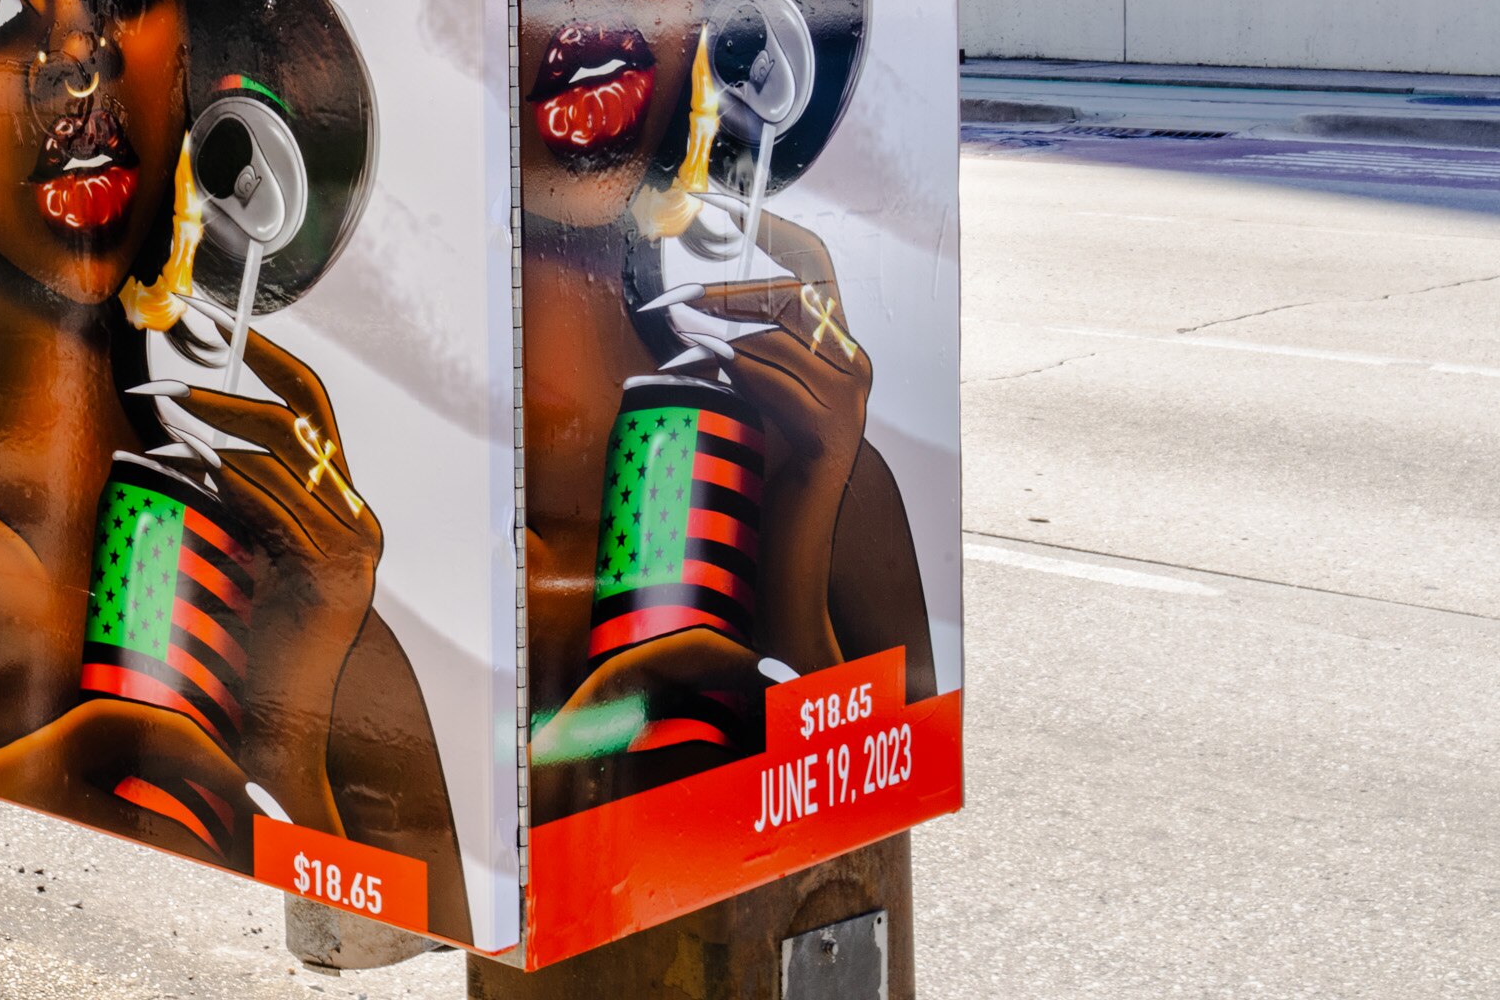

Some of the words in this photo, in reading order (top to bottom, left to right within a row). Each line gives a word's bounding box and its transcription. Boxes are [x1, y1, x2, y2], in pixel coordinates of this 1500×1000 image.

[800, 682, 873, 741] $18.65
[753, 754, 819, 833] JUNE
[826, 743, 857, 804] 19,
[863, 722, 913, 796] 2023
[293, 850, 383, 915] $18.65
